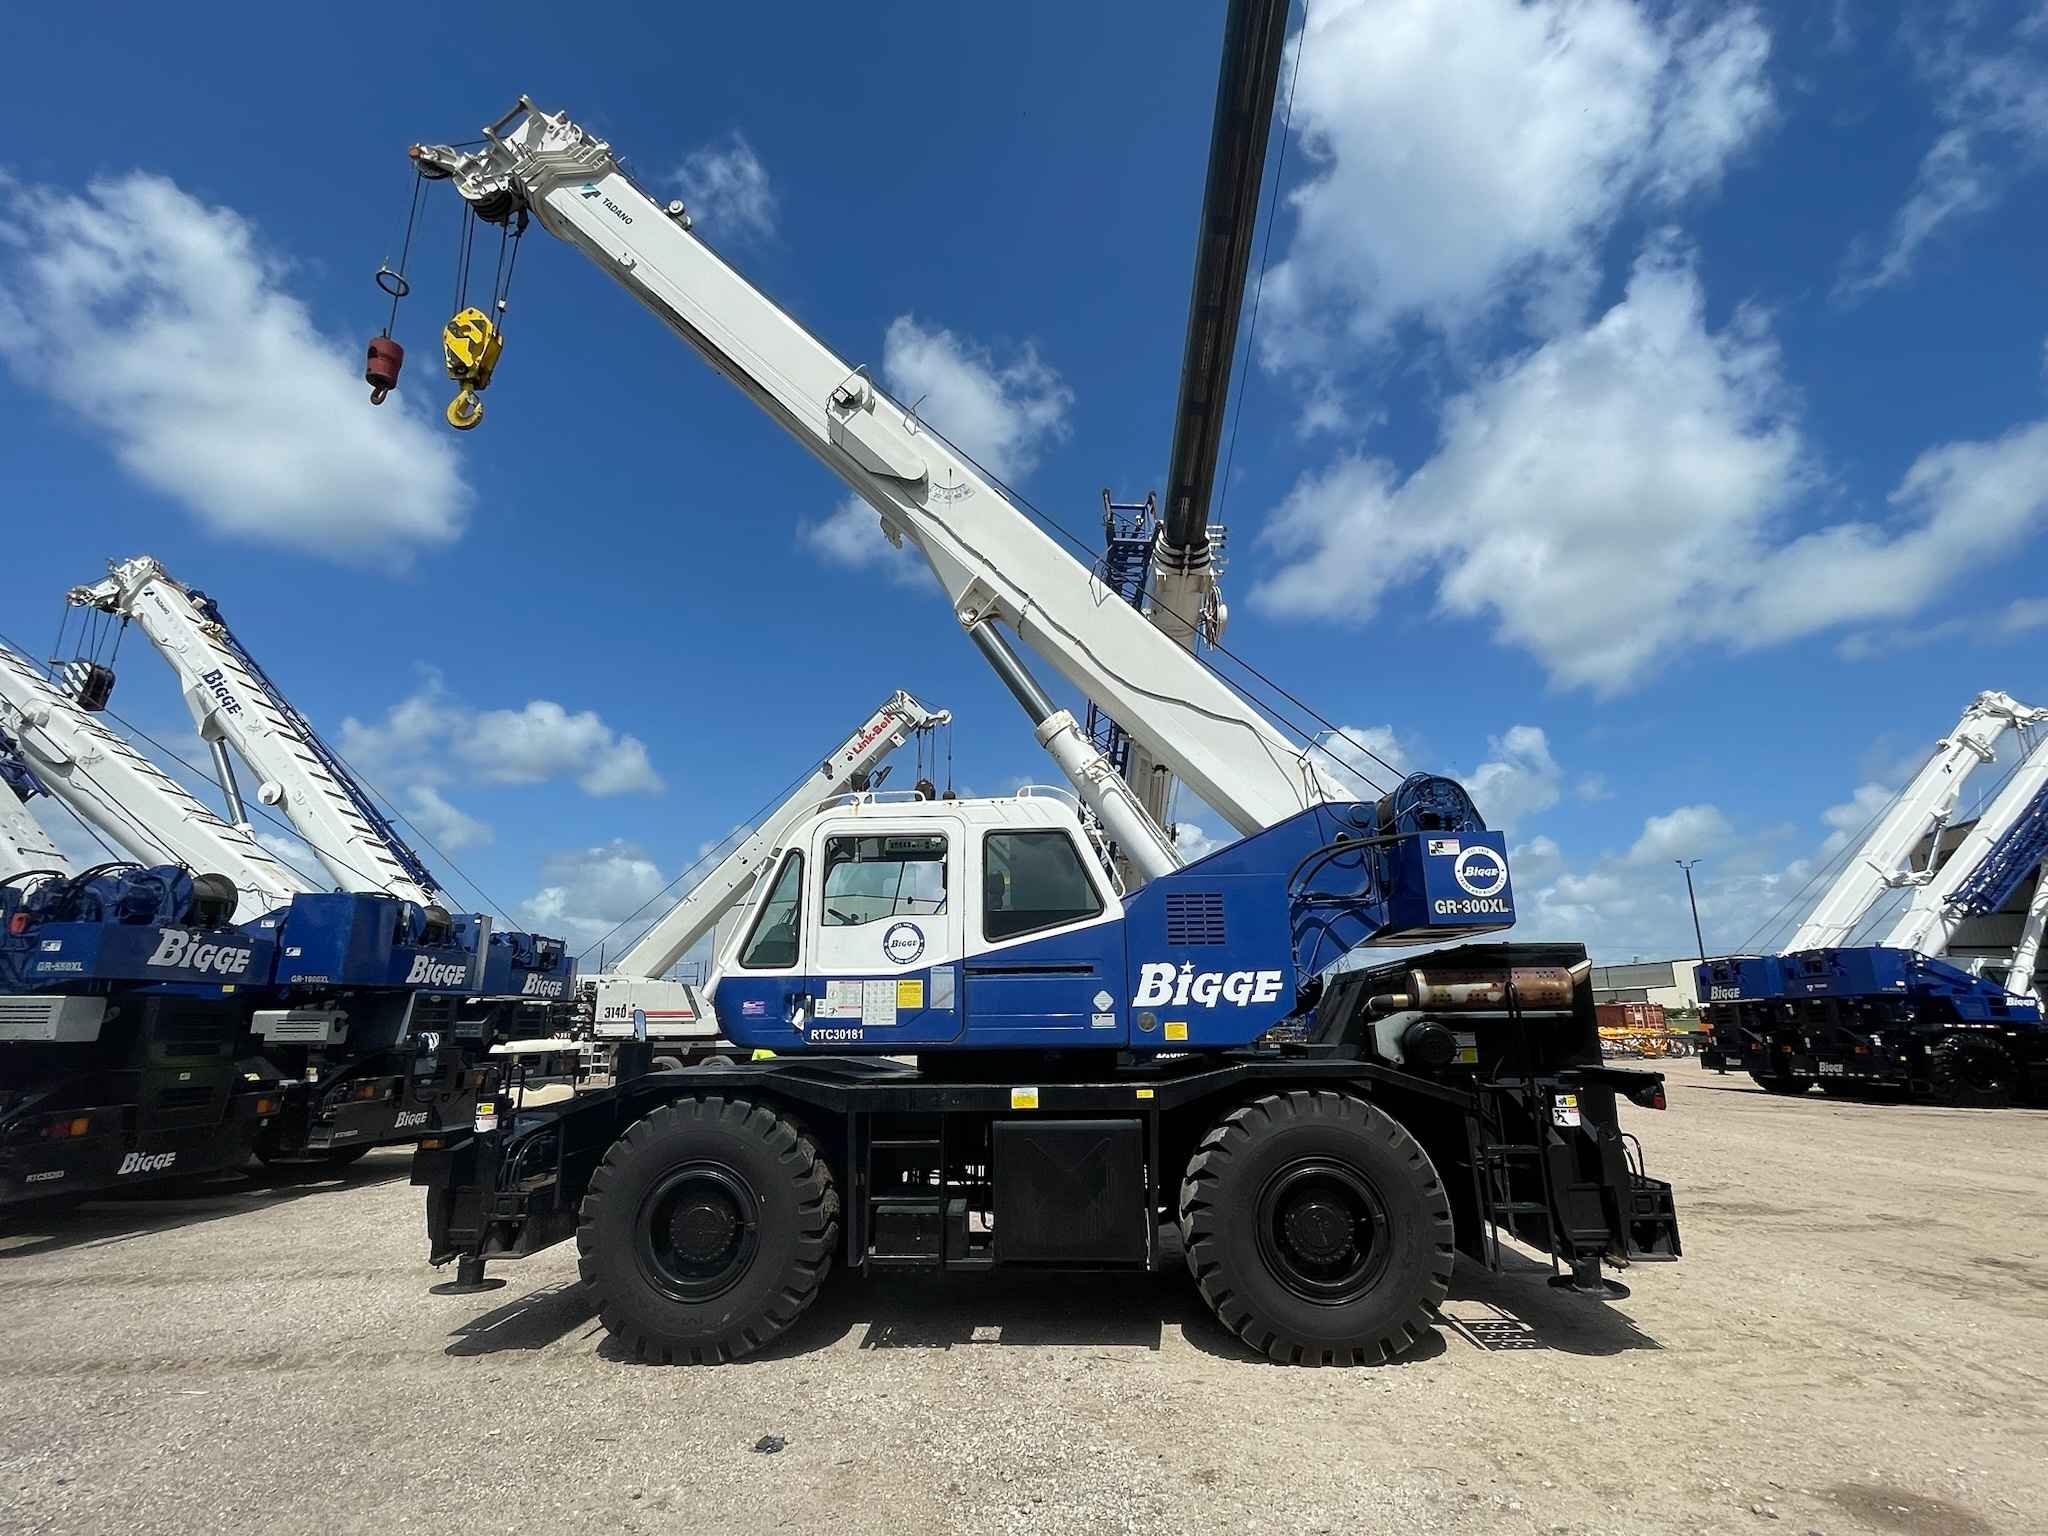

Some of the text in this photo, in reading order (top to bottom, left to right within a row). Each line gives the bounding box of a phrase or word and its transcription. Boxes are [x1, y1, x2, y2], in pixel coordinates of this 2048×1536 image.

[602, 197, 633, 225] TADANO
[1434, 898, 1509, 914] GR-300XL
[810, 1028, 864, 1041] RTC30181
